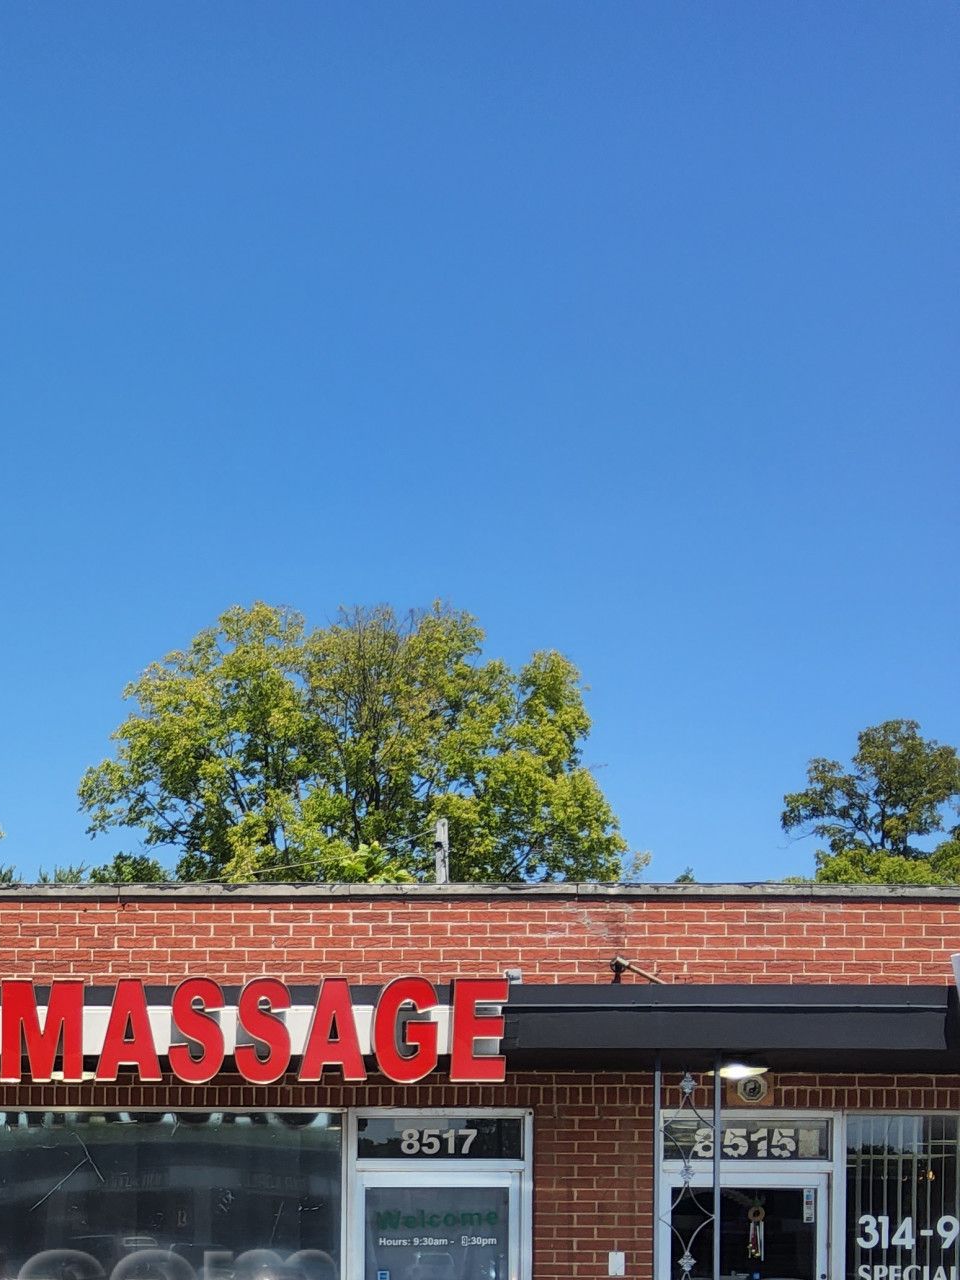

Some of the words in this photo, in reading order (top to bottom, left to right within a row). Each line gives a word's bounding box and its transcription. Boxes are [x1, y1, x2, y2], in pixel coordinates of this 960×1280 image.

[0, 975, 510, 1085] MASSAGE
[400, 1127, 478, 1155] 8517
[693, 1127, 797, 1158] 8515
[374, 1208, 500, 1232] Welcome
[378, 1236, 411, 1247] Hours:
[413, 1236, 448, 1247] 9:30am
